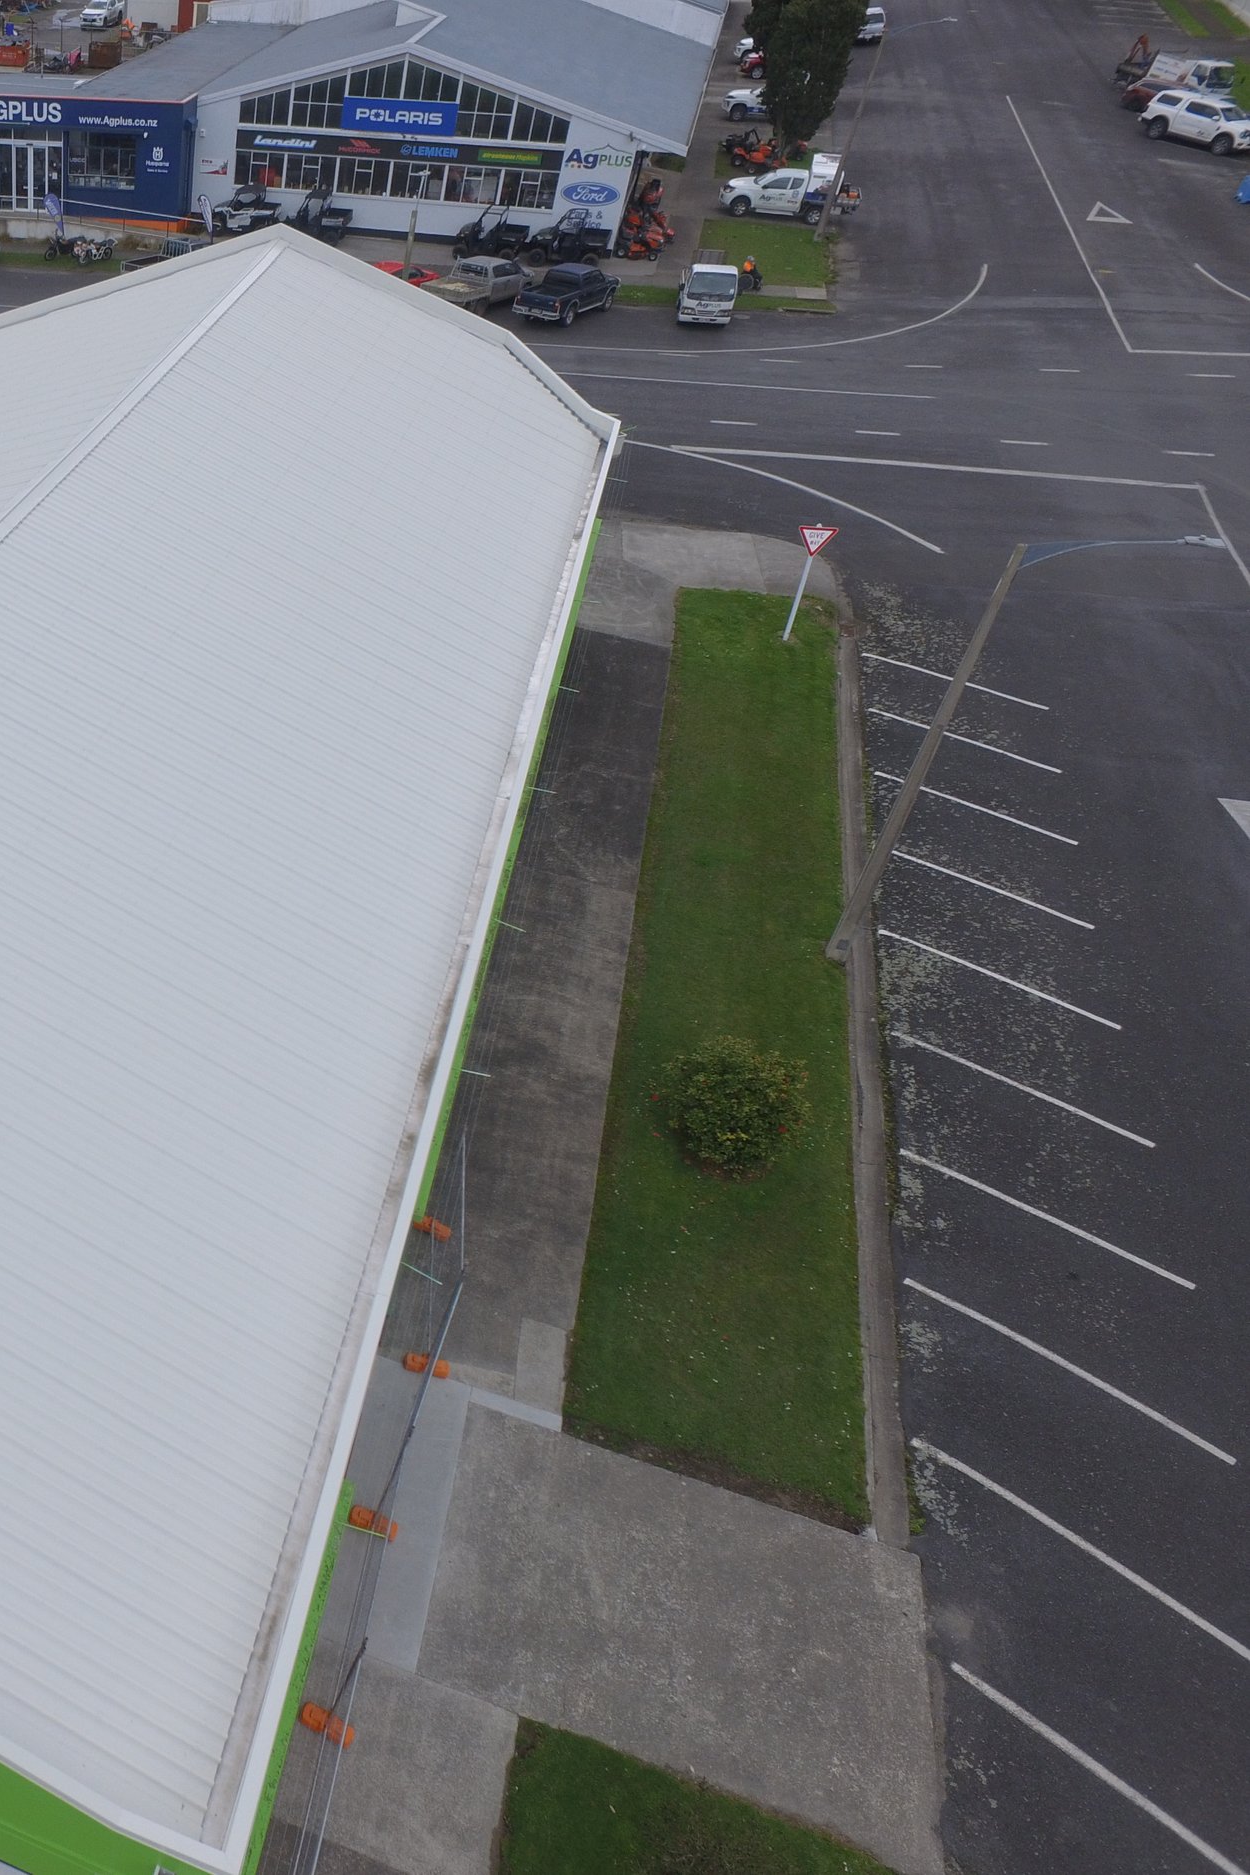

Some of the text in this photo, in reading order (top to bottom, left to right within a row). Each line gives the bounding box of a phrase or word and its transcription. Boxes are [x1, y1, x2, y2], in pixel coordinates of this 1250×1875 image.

[78, 115, 158, 128] www.Agplus.co.nz
[355, 107, 443, 126] POLARIS
[253, 135, 318, 149] Landini
[412, 146, 458, 159] LEMKEN
[572, 185, 608, 202] Ford
[596, 210, 602, 220] &
[809, 531, 825, 539] GIVE
